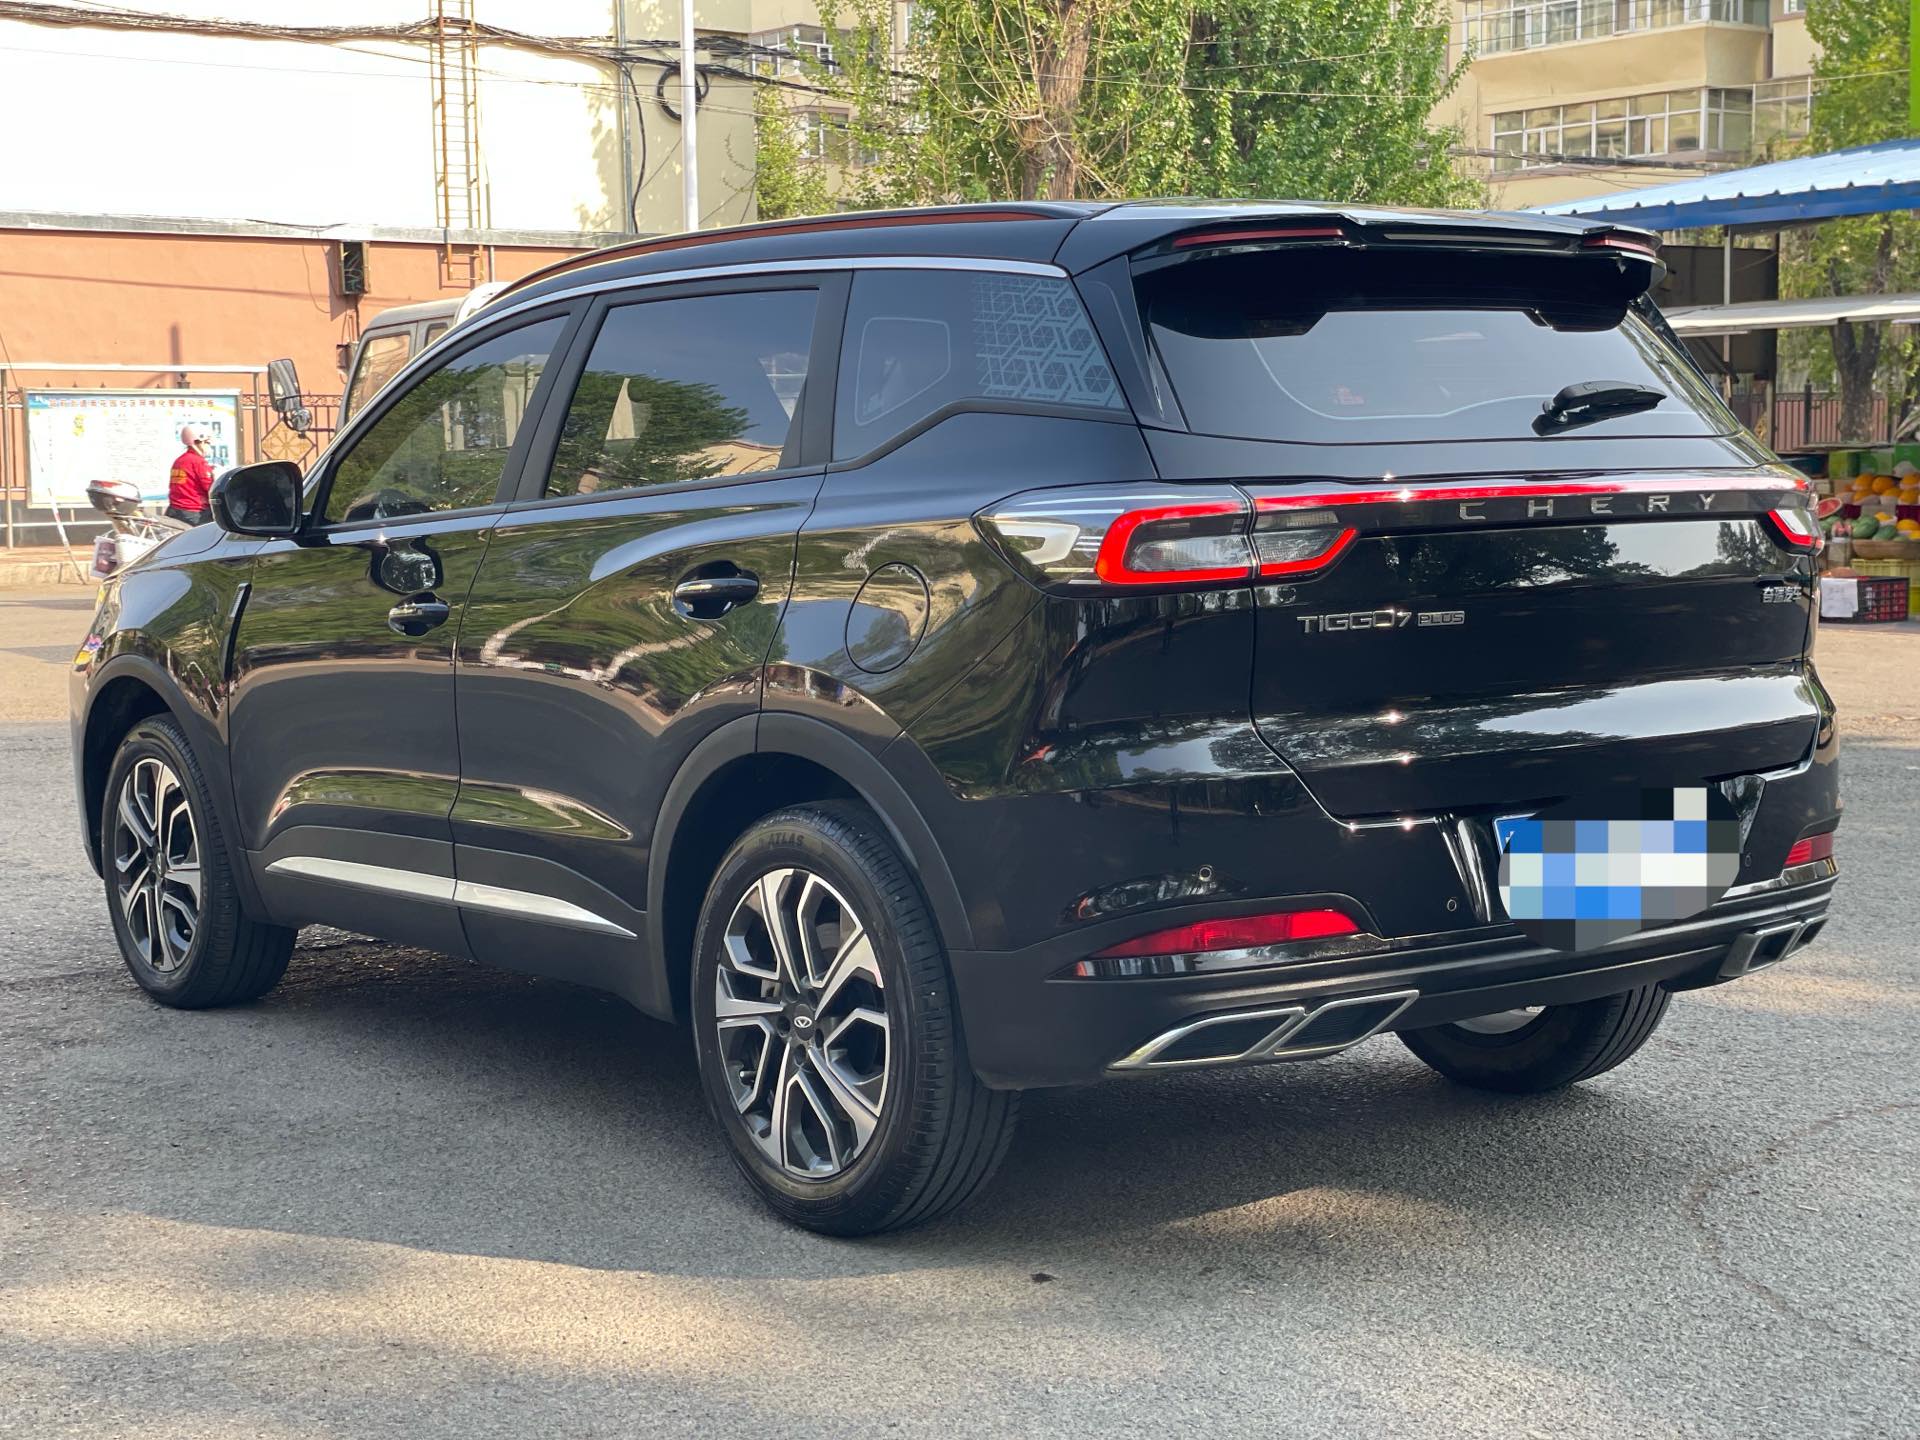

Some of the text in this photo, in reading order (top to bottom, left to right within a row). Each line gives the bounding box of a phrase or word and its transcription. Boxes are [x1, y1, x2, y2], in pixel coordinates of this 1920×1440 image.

[1459, 493, 1716, 520] CHERY
[1762, 586, 1802, 603] 奇瑞汽车
[1418, 611, 1465, 627] PLUS
[768, 832, 804, 846] ATLAS
